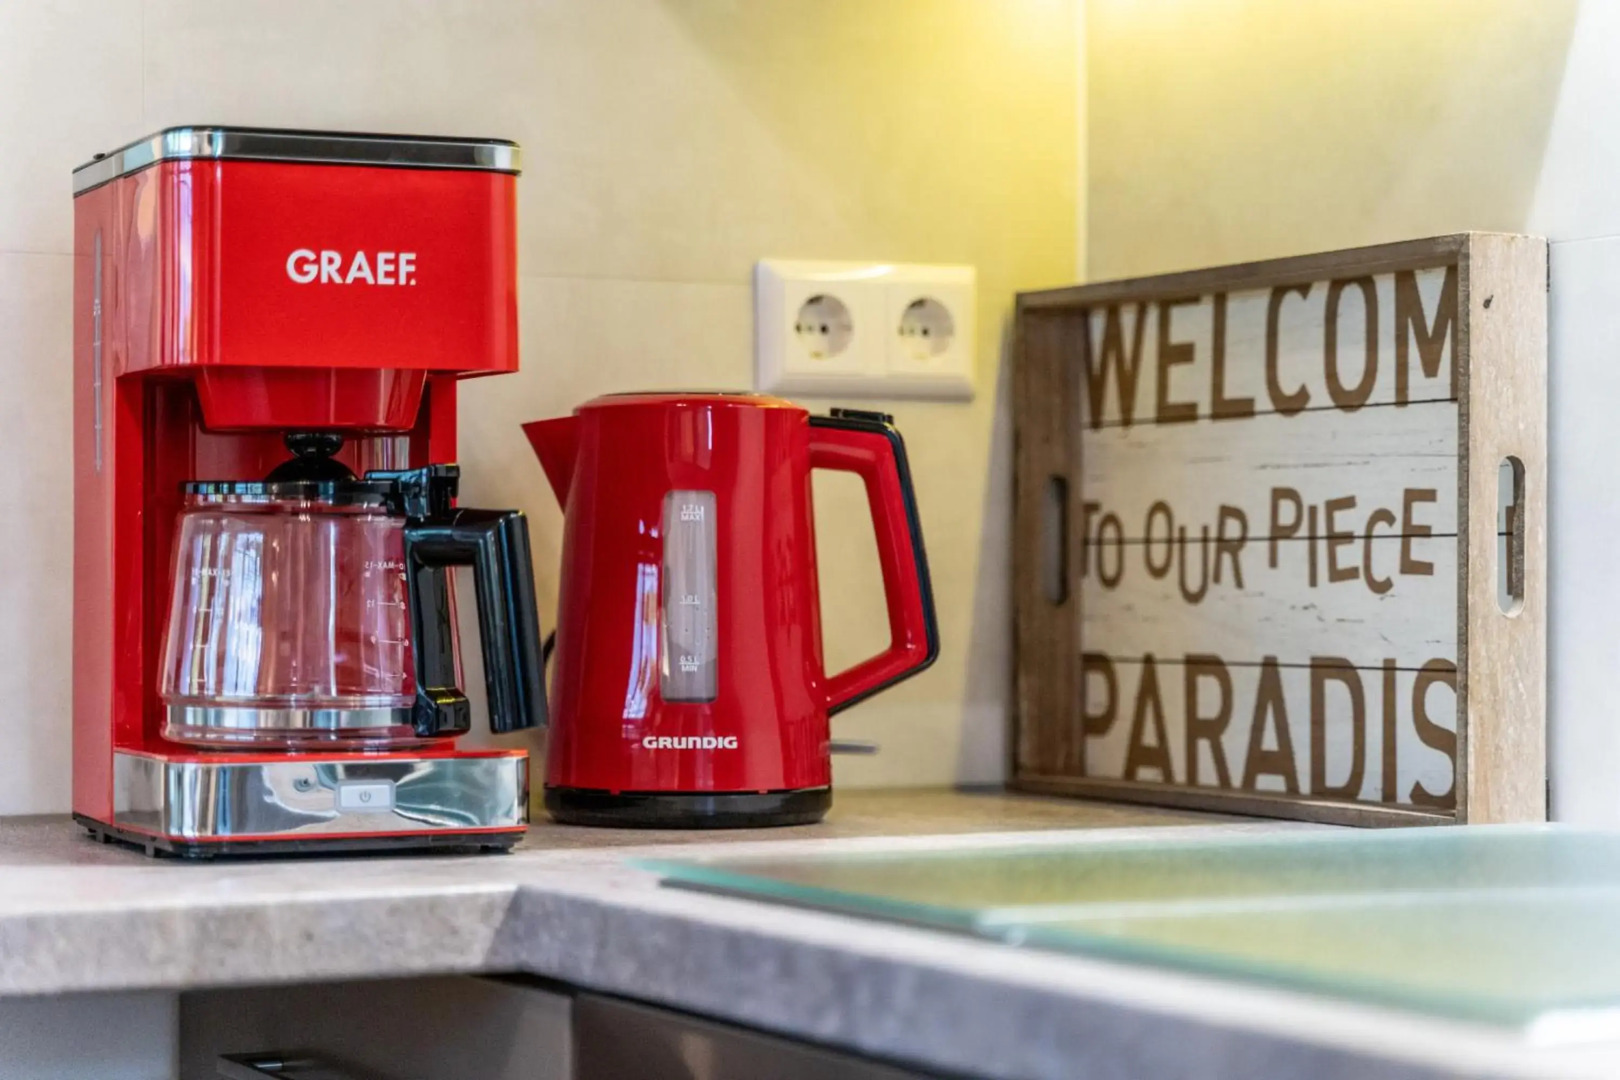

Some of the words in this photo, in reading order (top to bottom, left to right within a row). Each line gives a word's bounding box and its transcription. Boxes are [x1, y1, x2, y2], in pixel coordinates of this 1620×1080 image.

[1085, 266, 1458, 431] WELCOM
[1080, 503, 1124, 589] TO
[1145, 500, 1249, 605] OUR
[1269, 487, 1437, 595] PIECE
[642, 736, 738, 750] GRUNDIG
[1083, 652, 1458, 805] PARADIS
